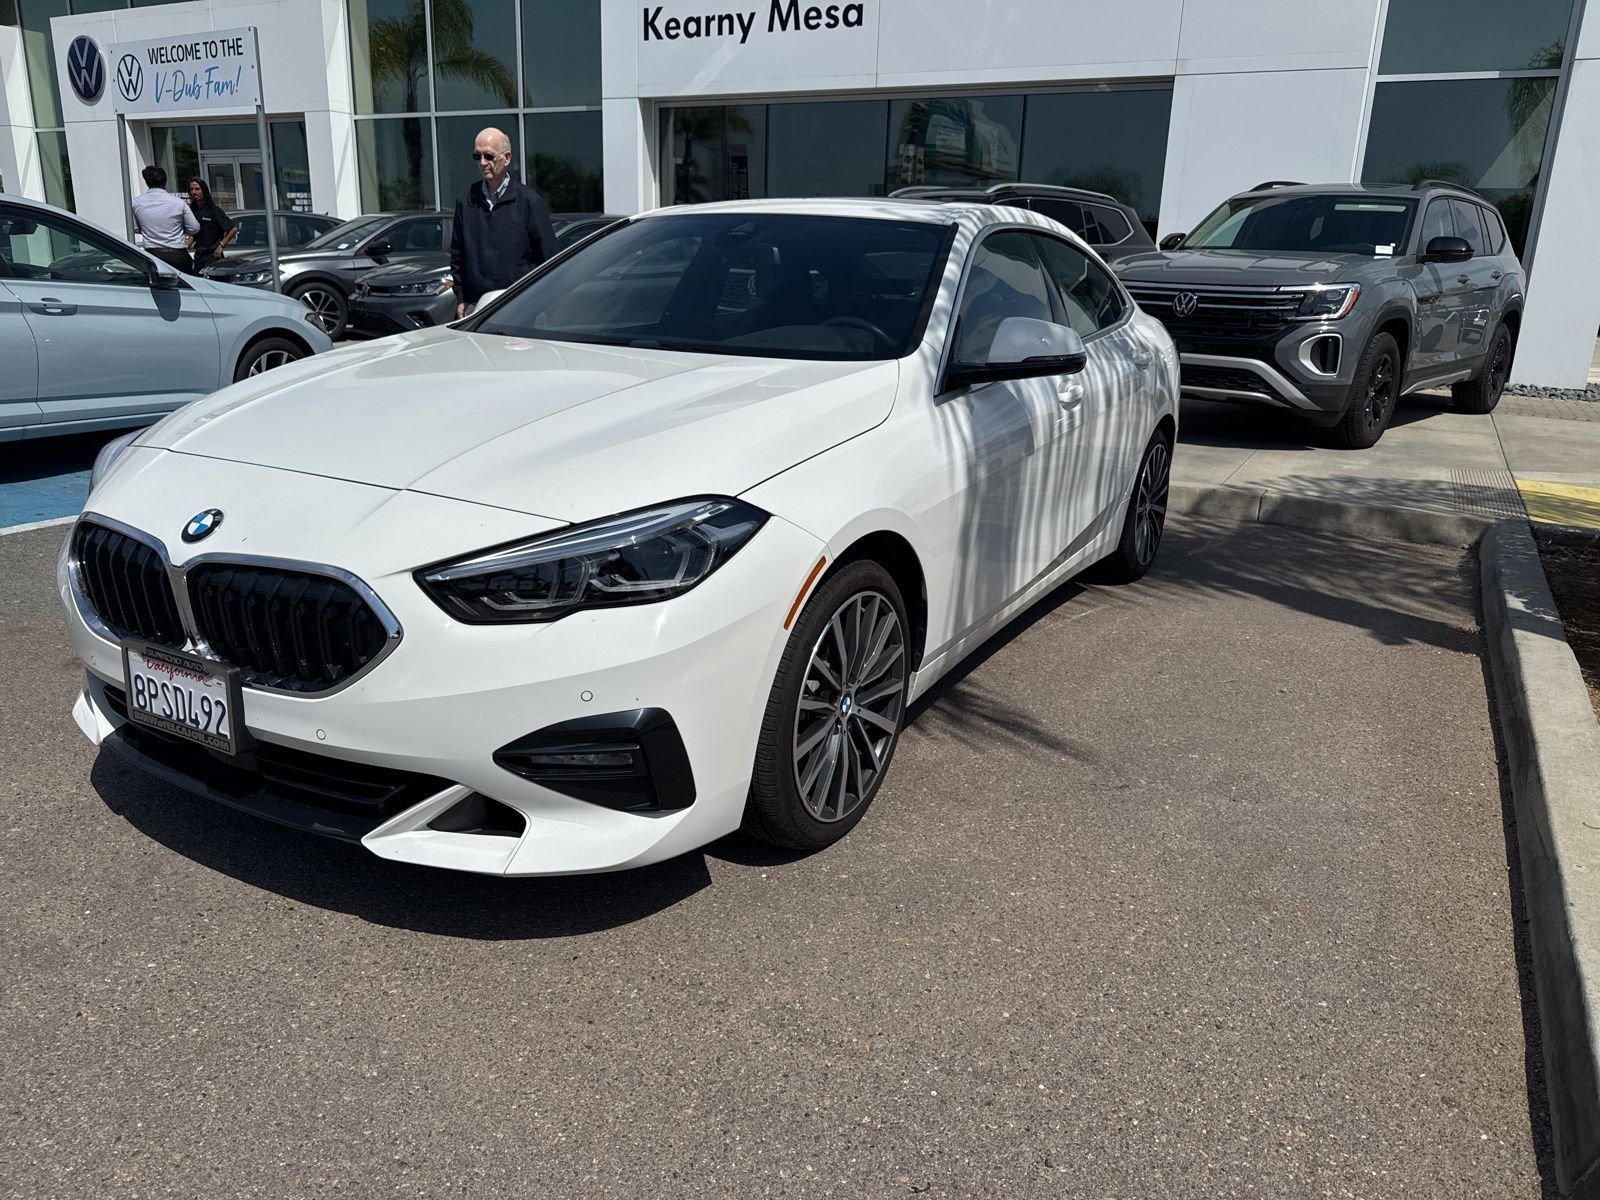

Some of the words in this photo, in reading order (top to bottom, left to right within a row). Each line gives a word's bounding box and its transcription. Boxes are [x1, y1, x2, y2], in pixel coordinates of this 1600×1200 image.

[643, 7, 756, 44] Kearny
[767, 0, 864, 32] Mesa
[148, 42, 201, 65] WELCOME
[203, 40, 218, 59] TO
[220, 38, 243, 57] THE
[155, 70, 201, 103] V-Dub
[204, 65, 242, 99] Fam!
[134, 674, 229, 740] 8PSD492
